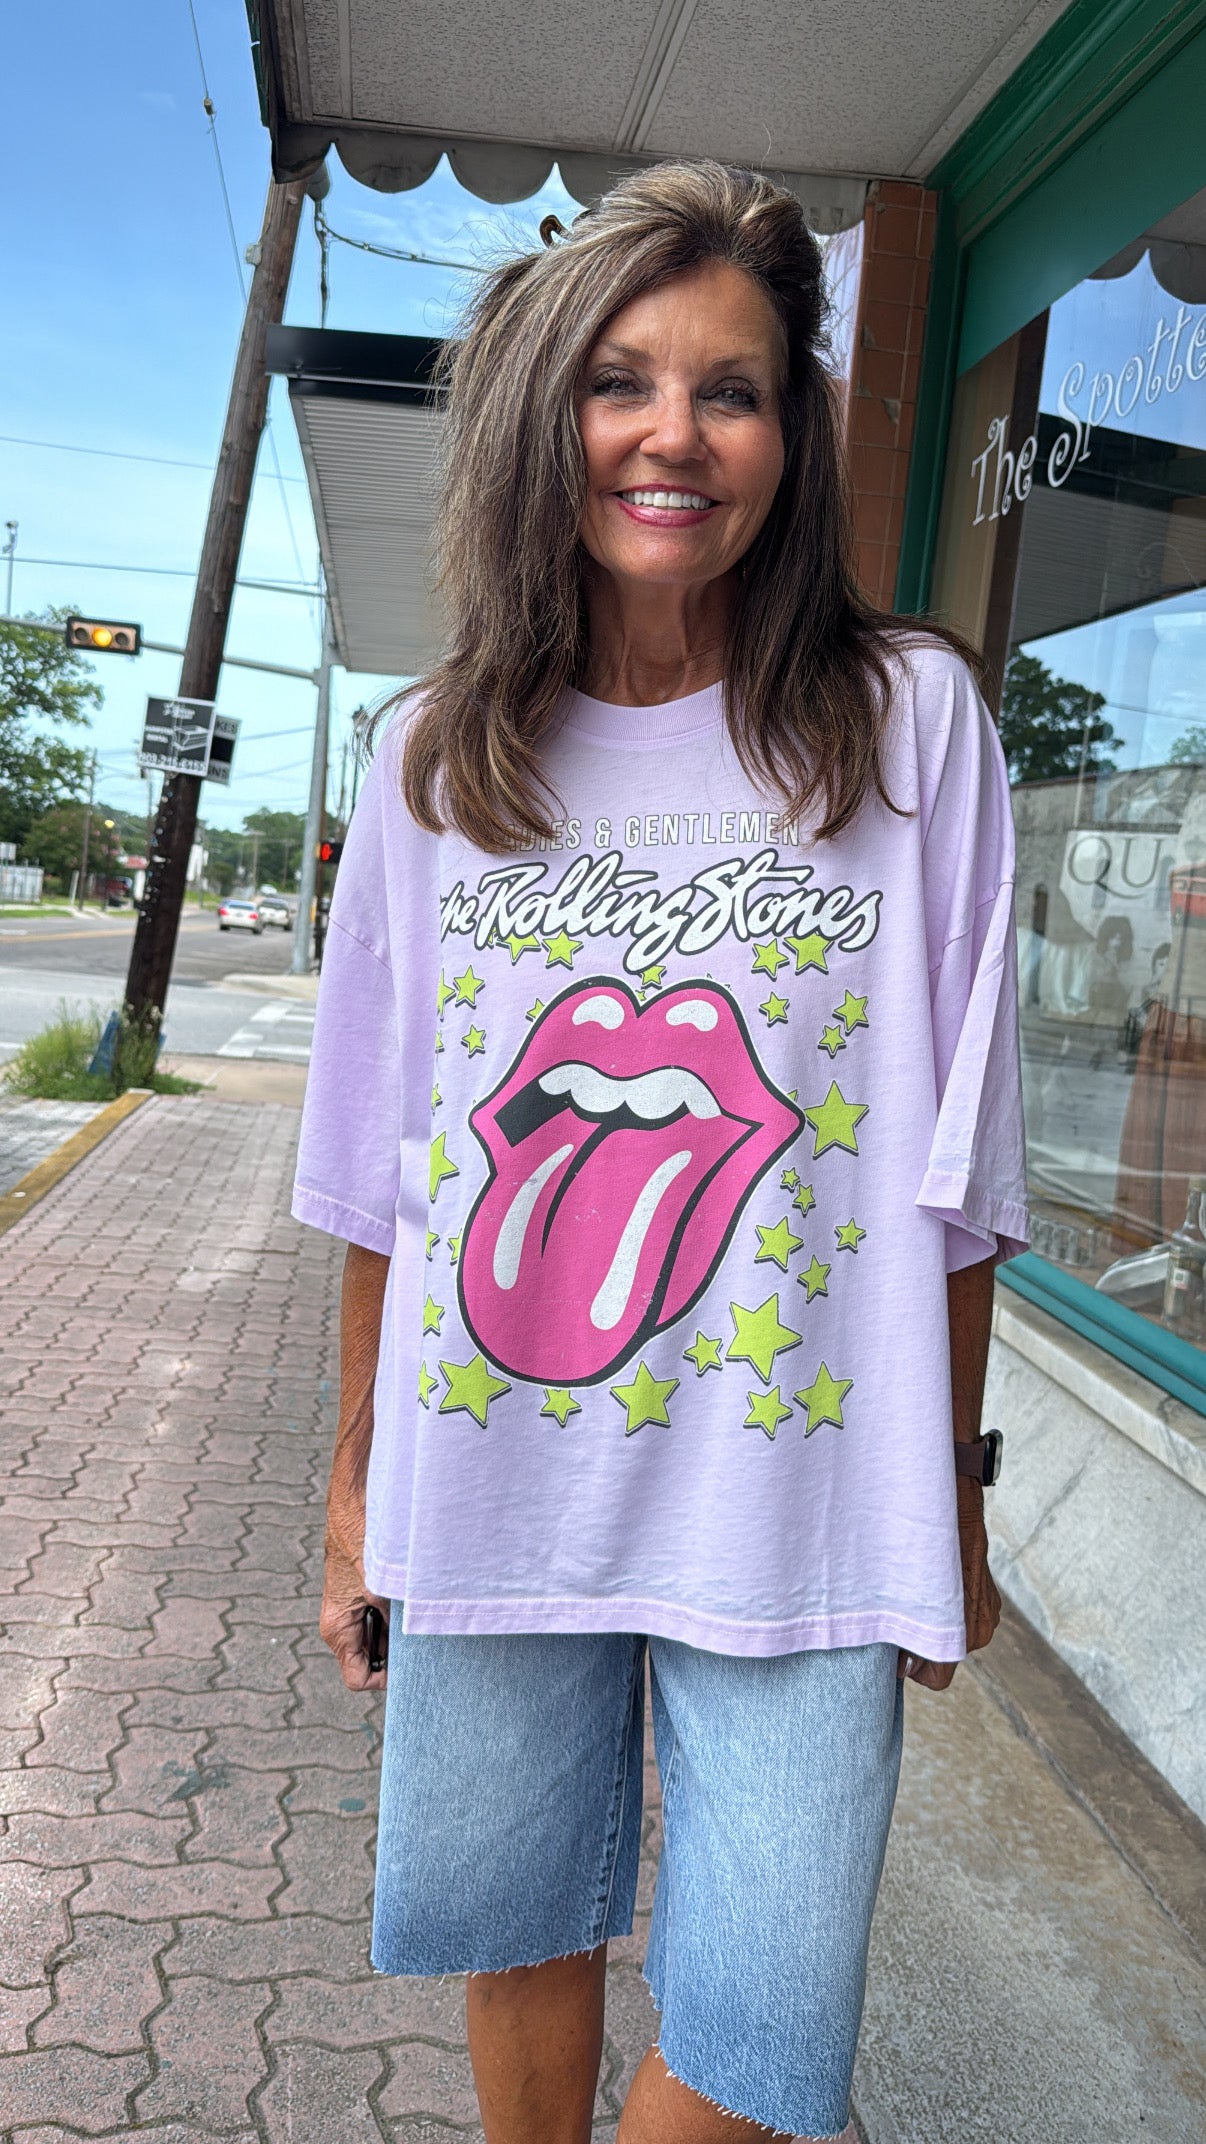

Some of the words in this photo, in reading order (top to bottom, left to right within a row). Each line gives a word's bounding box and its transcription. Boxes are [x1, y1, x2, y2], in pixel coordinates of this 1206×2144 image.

[970, 413, 1038, 527] The
[594, 817, 613, 849] &
[624, 811, 800, 848] GENTLEMEN
[474, 849, 692, 975] Rolling
[678, 849, 884, 957] Stones
